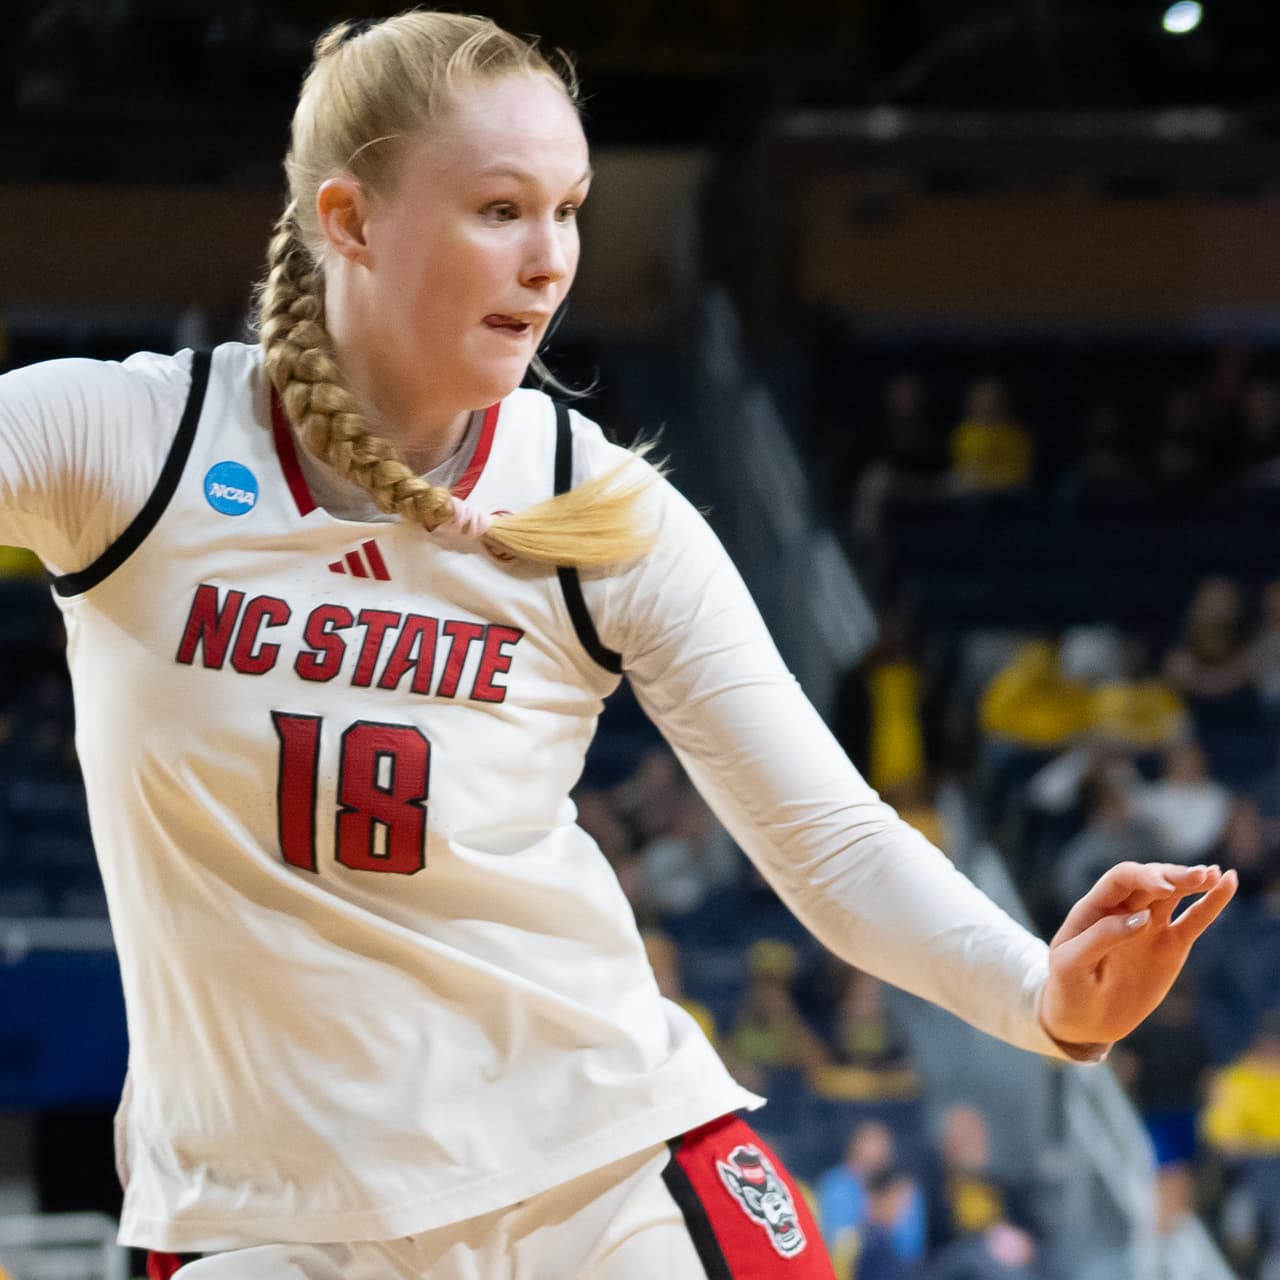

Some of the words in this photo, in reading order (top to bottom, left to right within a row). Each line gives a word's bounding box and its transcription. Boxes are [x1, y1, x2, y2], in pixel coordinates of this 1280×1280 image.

[208, 482, 256, 507] NCAA
[175, 584, 293, 676] NC
[294, 604, 525, 703] STATE
[270, 709, 432, 876] 18
